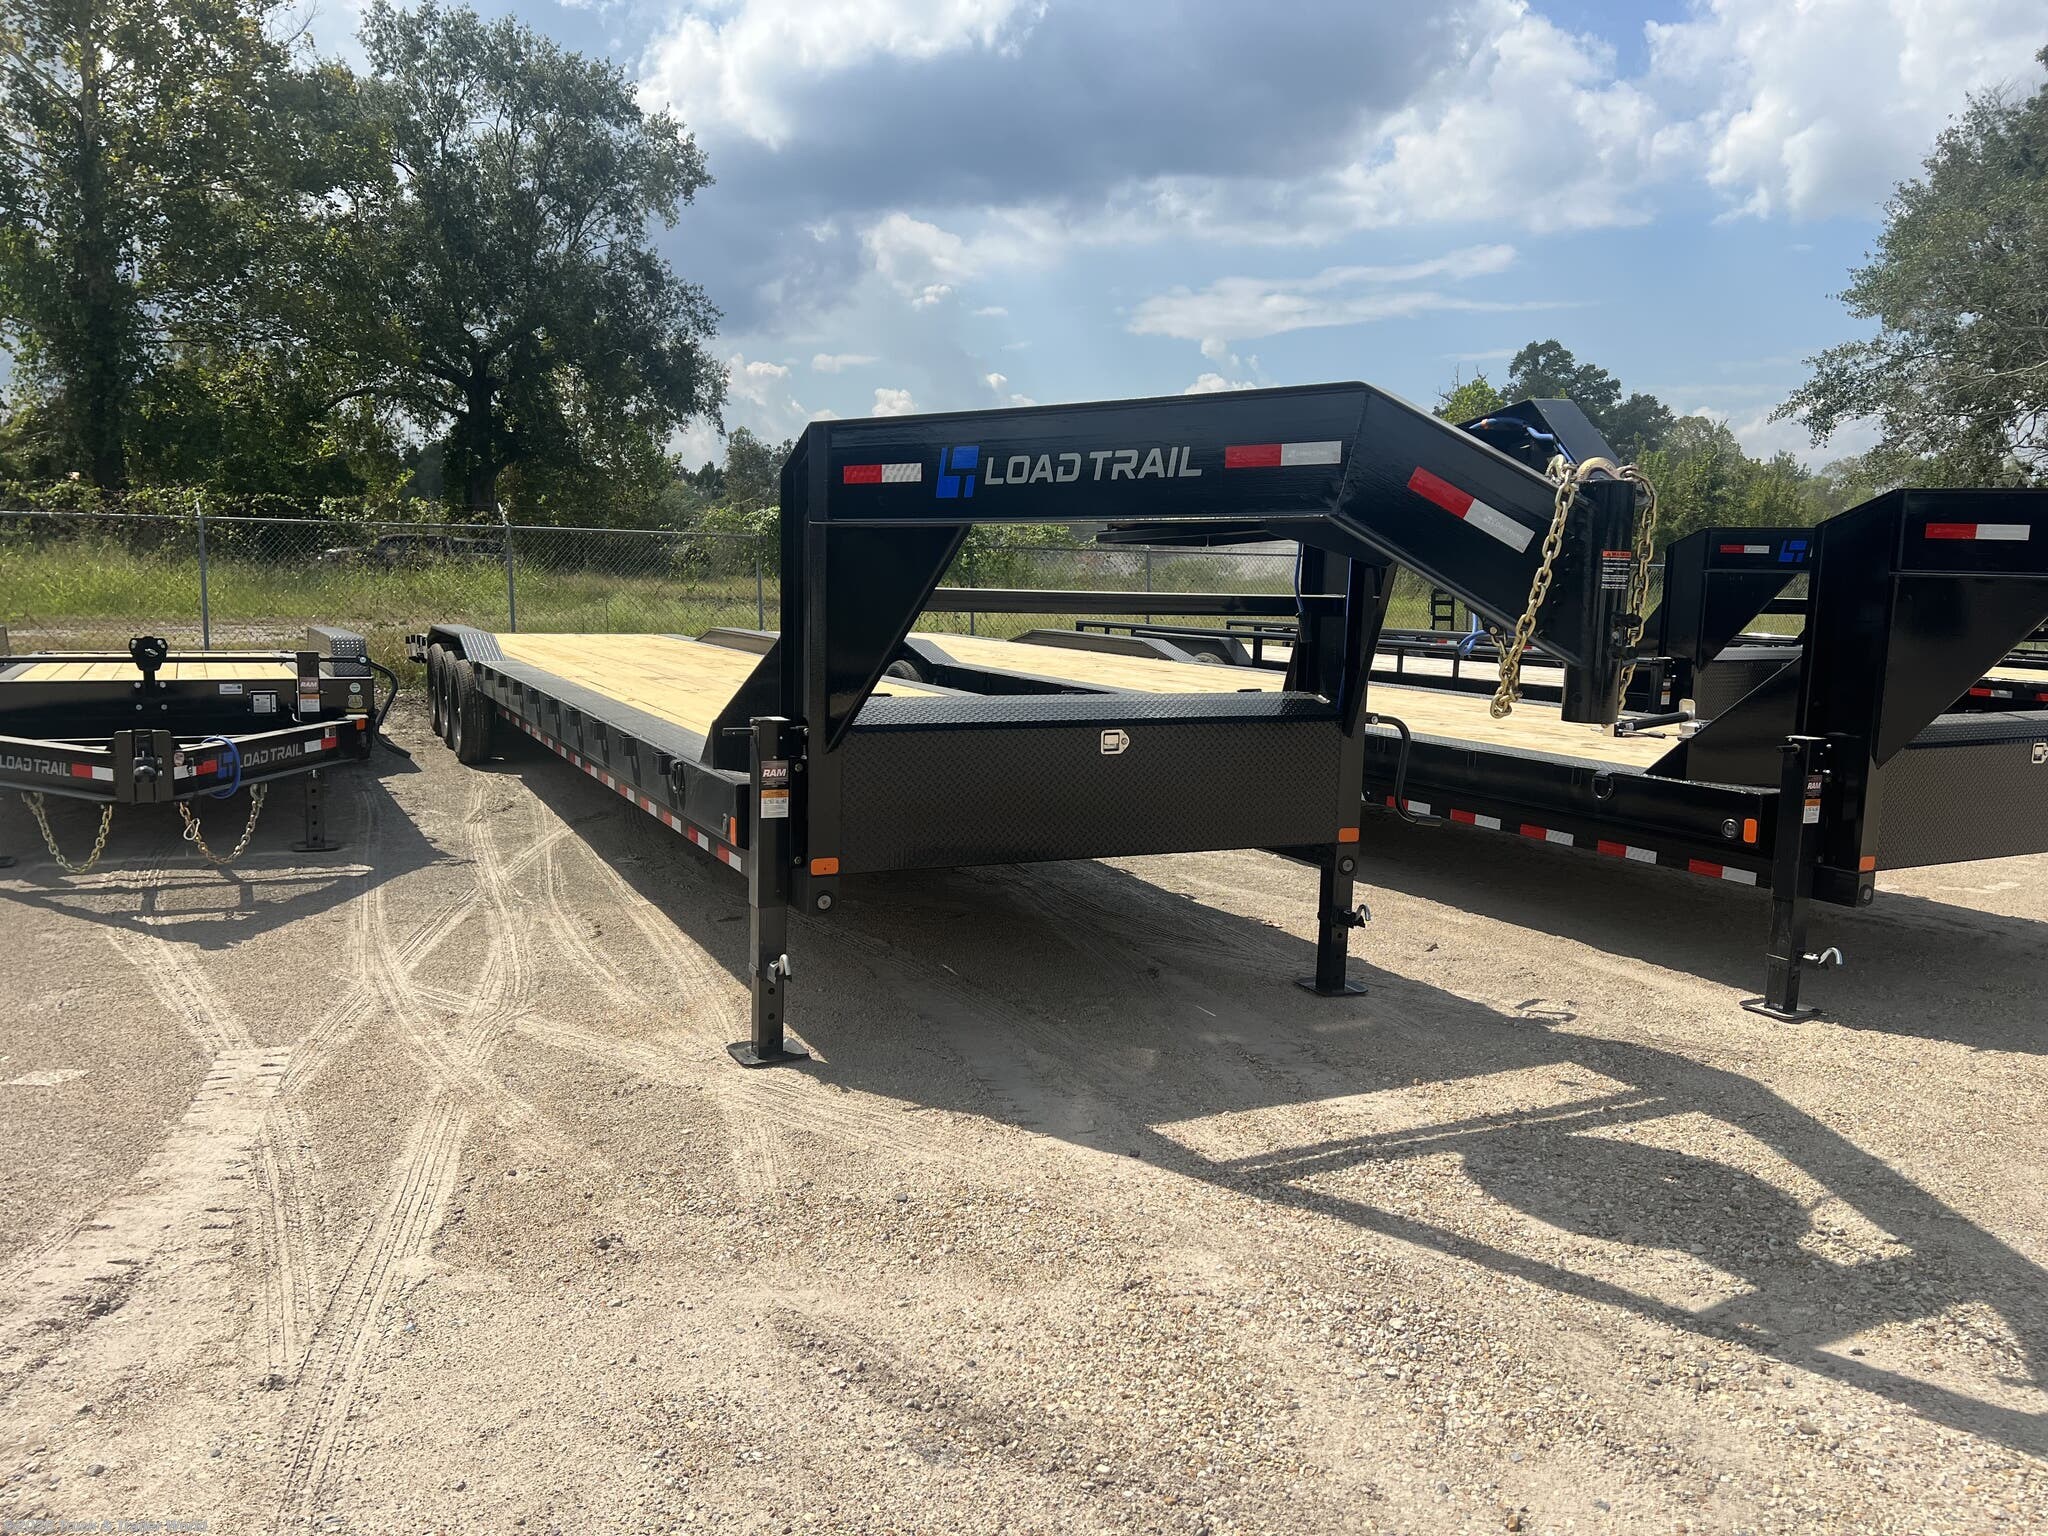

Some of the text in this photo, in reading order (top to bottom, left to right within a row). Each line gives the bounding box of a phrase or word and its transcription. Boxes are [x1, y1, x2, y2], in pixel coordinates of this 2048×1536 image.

[984, 452, 1083, 486] LOAD
[1088, 446, 1204, 482] TRAIL
[270, 743, 302, 761] TRAIL
[0, 755, 71, 777] LOAD TRAIL
[762, 768, 787, 778] RAM
